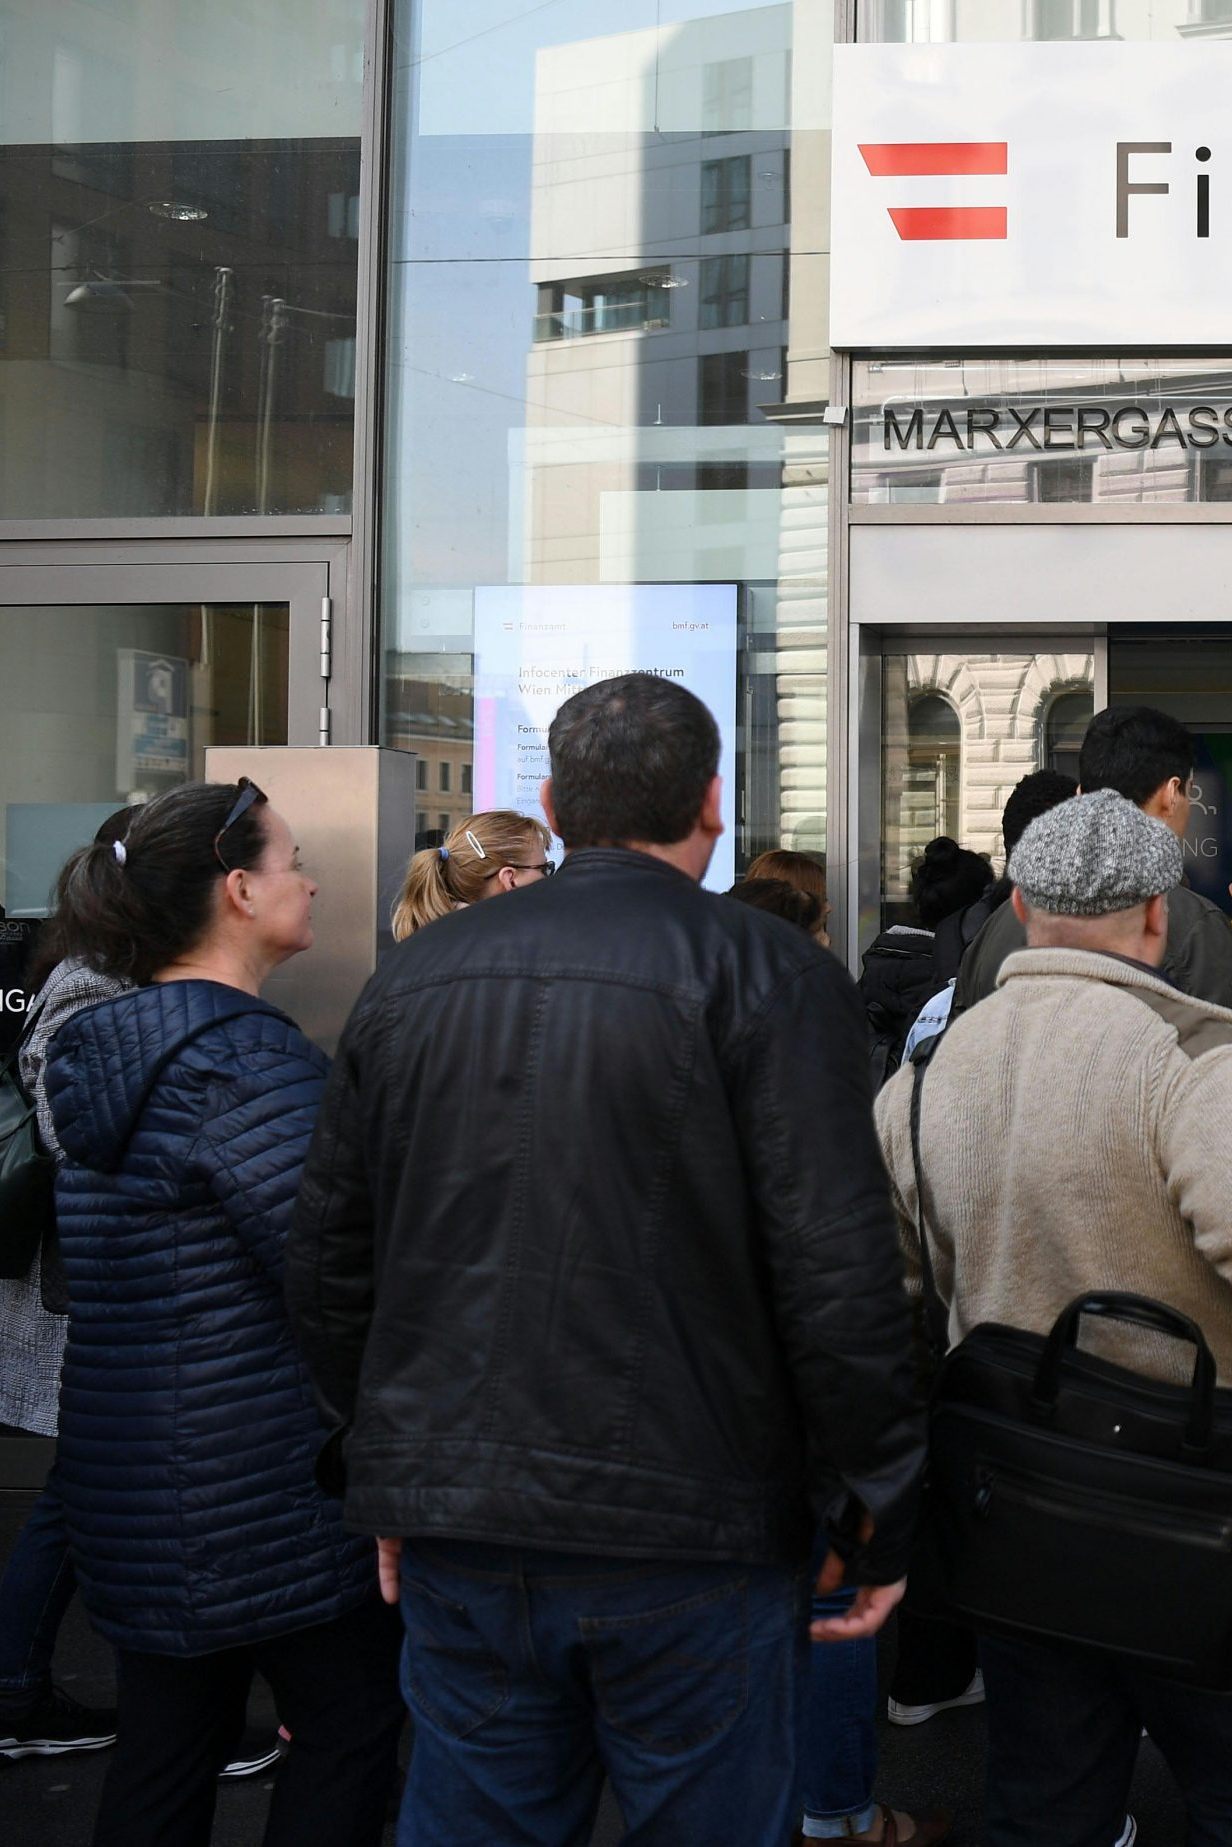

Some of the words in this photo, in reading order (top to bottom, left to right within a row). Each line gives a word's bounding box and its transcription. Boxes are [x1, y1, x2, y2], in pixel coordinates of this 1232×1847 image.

[519, 622, 567, 631] Finanzamt
[672, 621, 709, 632] bmf.gv.at
[518, 666, 586, 678] Infocenter
[518, 684, 551, 695] Wien
[556, 684, 583, 695] Mitt
